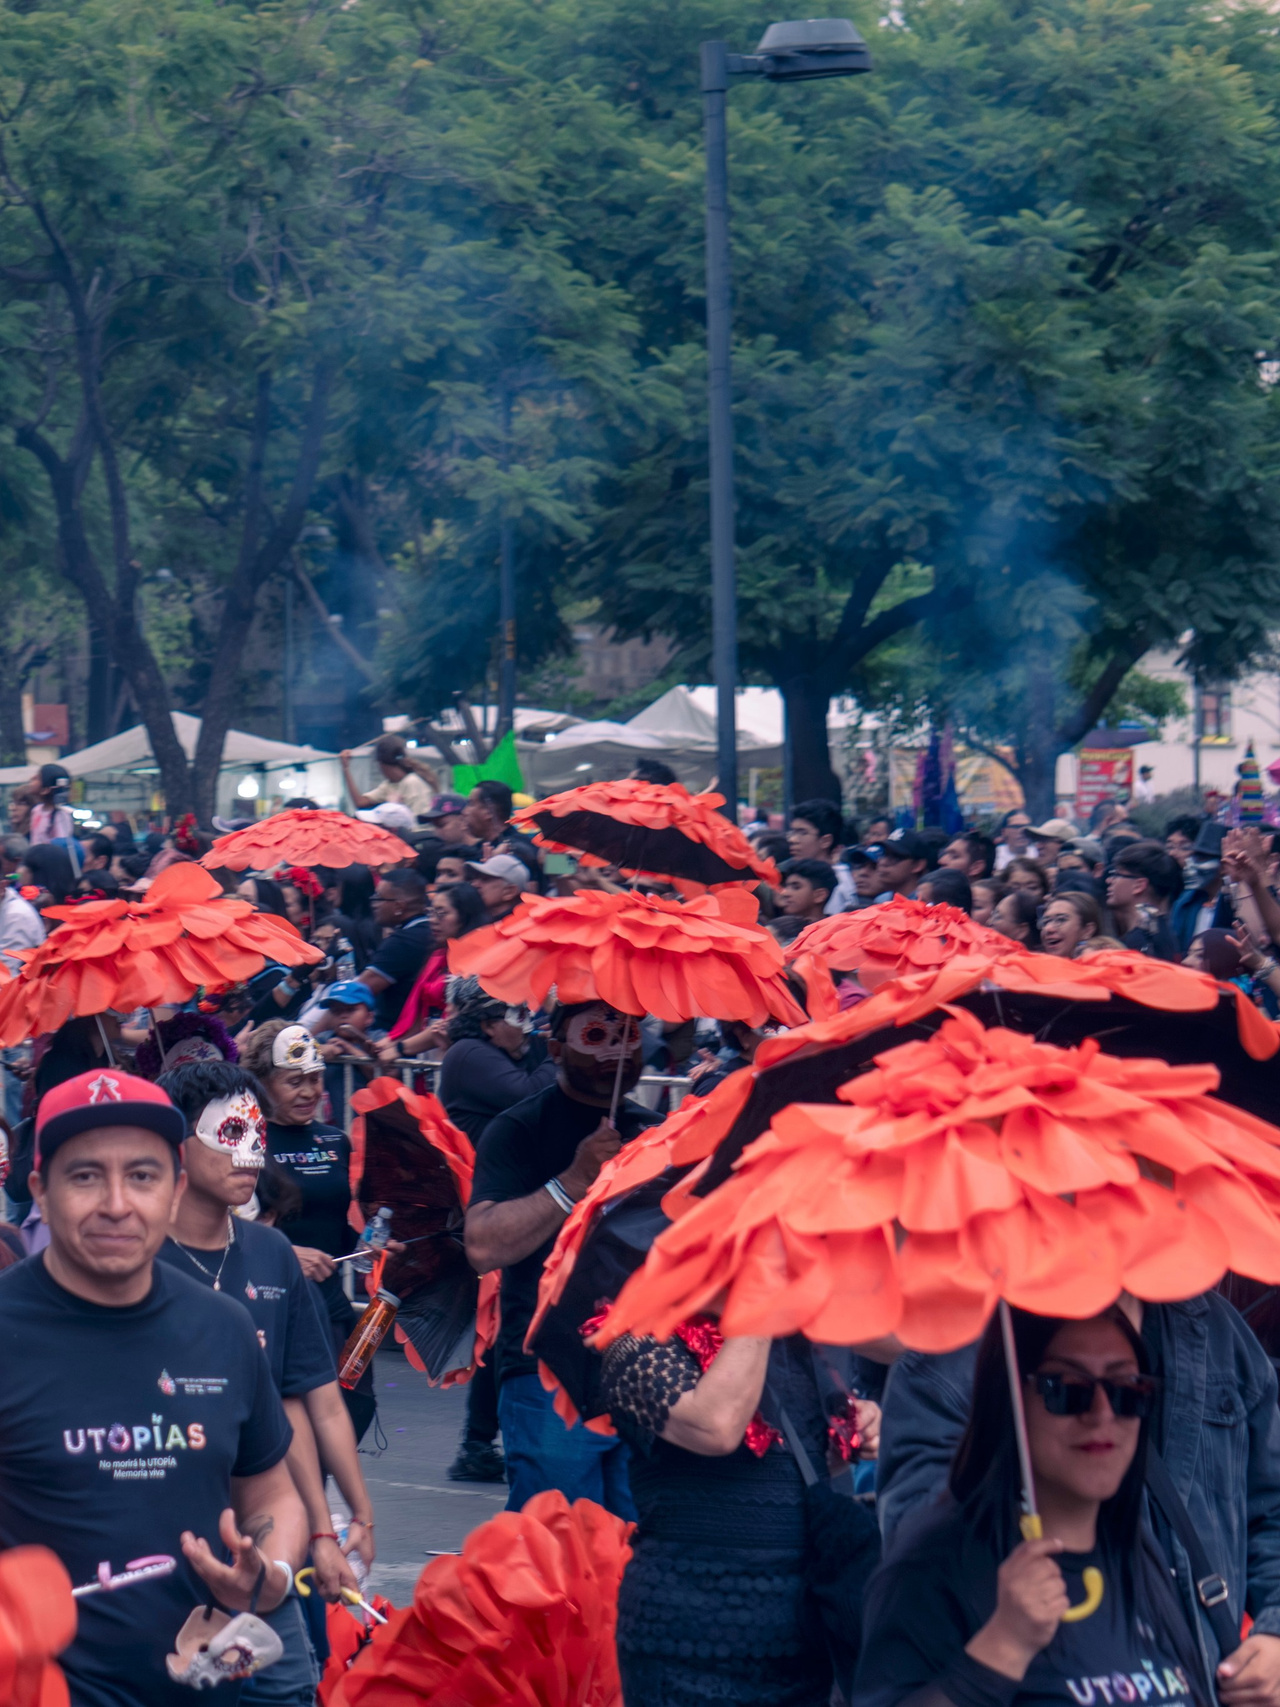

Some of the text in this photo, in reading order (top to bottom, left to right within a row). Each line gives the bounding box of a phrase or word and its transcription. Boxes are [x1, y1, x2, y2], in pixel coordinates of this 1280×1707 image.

[99, 1455, 177, 1470] No morirá la UTOPÍA
[113, 1467, 166, 1480] Memoria viva
